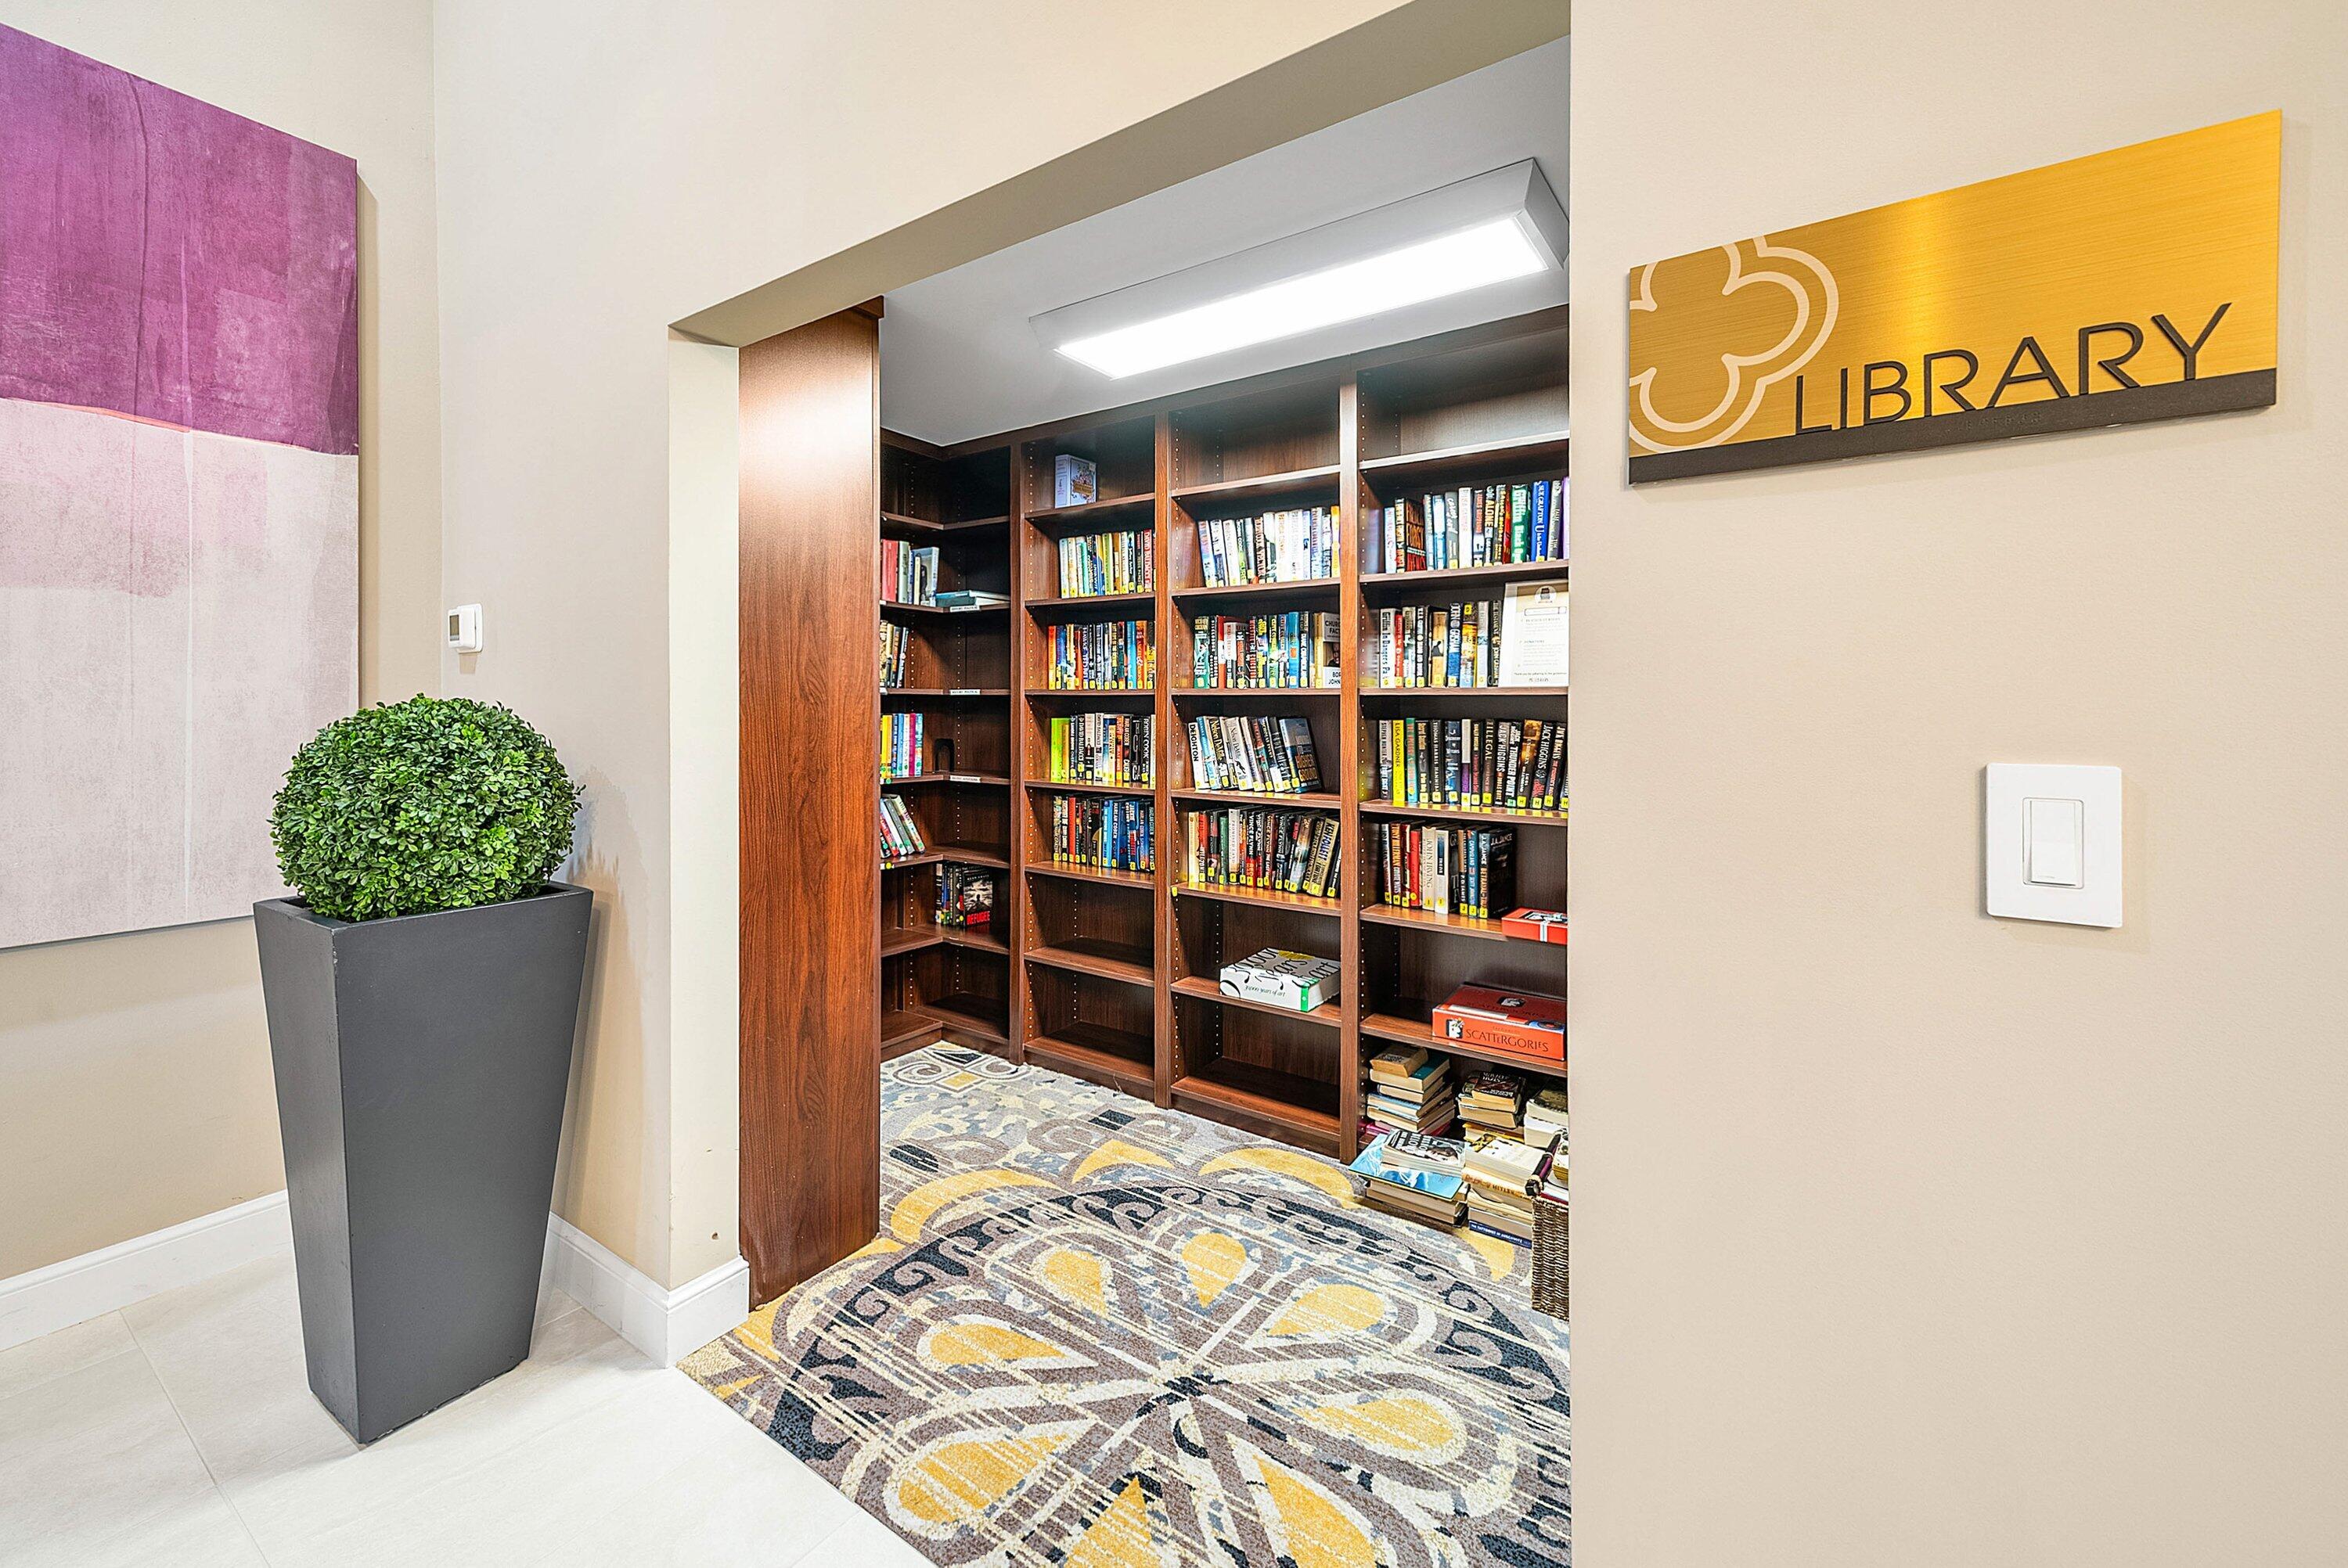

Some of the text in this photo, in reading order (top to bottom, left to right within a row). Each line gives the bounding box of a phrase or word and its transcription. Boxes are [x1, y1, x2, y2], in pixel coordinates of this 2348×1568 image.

[1796, 302, 2231, 436] LIBRARY
[1485, 500, 1494, 527] ALONE
[1513, 490, 1527, 523] Griffin
[1256, 550, 1266, 576] VECTOR
[1449, 605, 1460, 653] JOHN GRISHAM
[1381, 640, 1390, 665] Danger's
[1190, 725, 1198, 761] DEIGHTON
[1210, 720, 1225, 761] Nelson DeMille
[1538, 725, 1553, 769] JACK HIGGINS
[1496, 744, 1506, 771] HIGGINS
[1506, 746, 1518, 797] THUNDER POINT
[1319, 822, 1335, 861] KEN FOLLETT
[1500, 833, 1513, 843] JANCE
[967, 910, 990, 925] REFUGEE
[1466, 1029, 1549, 1052] SCATTERGORIES
[1477, 1225, 1496, 1234] TATTOOIST
[1501, 1233, 1522, 1243] AUSCHWITZ
